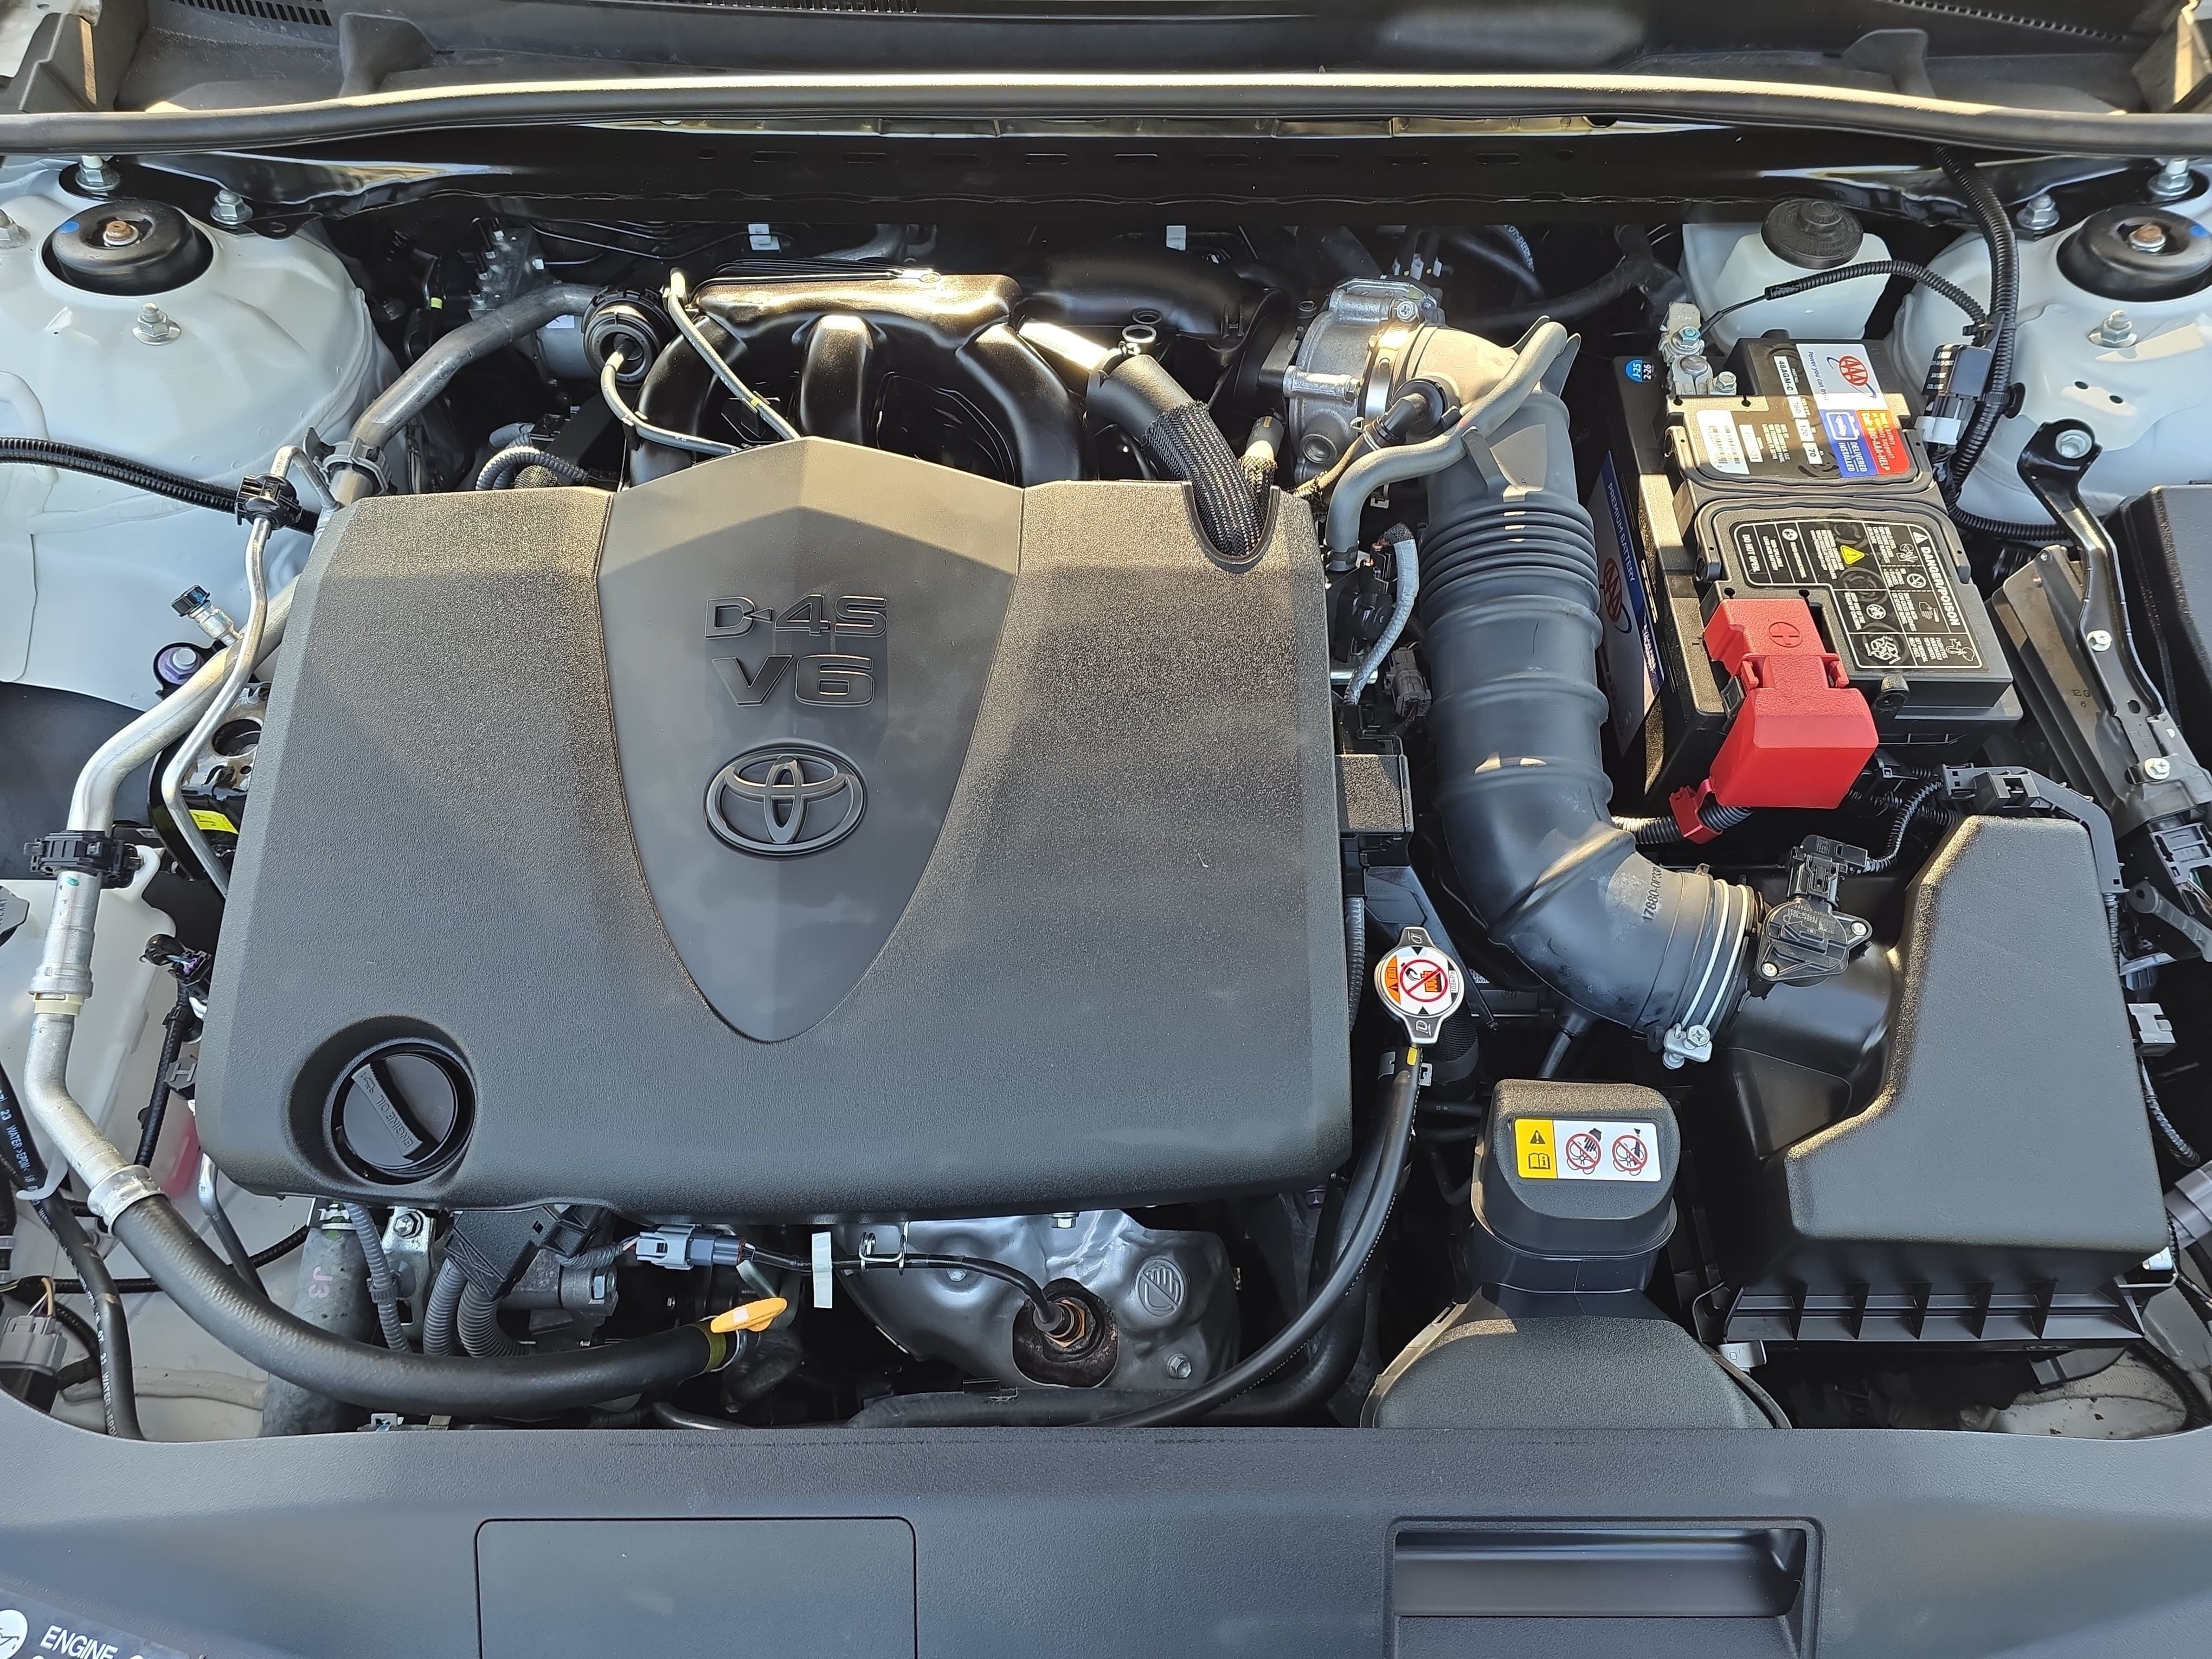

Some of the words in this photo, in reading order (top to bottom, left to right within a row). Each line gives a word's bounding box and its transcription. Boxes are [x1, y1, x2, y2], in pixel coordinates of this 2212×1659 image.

[1807, 351, 1816, 366] Power
[1643, 364, 1652, 380] 2-26
[1779, 361, 1793, 390] 48AGM-C
[1811, 368, 1820, 377] you
[1840, 356, 1867, 386] AAA
[1792, 401, 1801, 413] 760
[1800, 425, 1808, 436] 120
[1885, 428, 1895, 445] battery
[1808, 448, 1816, 456] 70
[1838, 442, 1855, 471] INSTALLED
[1850, 442, 1867, 471] DELIVERED
[1882, 439, 1895, 458] support?
[1607, 481, 1623, 534] PREMIUM
[1620, 532, 1636, 582] BATTERY
[1742, 534, 1751, 542] DO
[1745, 543, 1755, 555] NOT
[1921, 547, 1959, 625] DANGER/POISON
[712, 654, 876, 707] V6
[170, 1063, 197, 1083] H
[376, 1094, 390, 1113] OIL
[1, 1108, 12, 1122] 23
[7, 1123, 23, 1150] WATER
[385, 1110, 414, 1148] ENGINE
[102, 1371, 112, 1407] WATER
[40, 1624, 119, 1659] ENGINE
